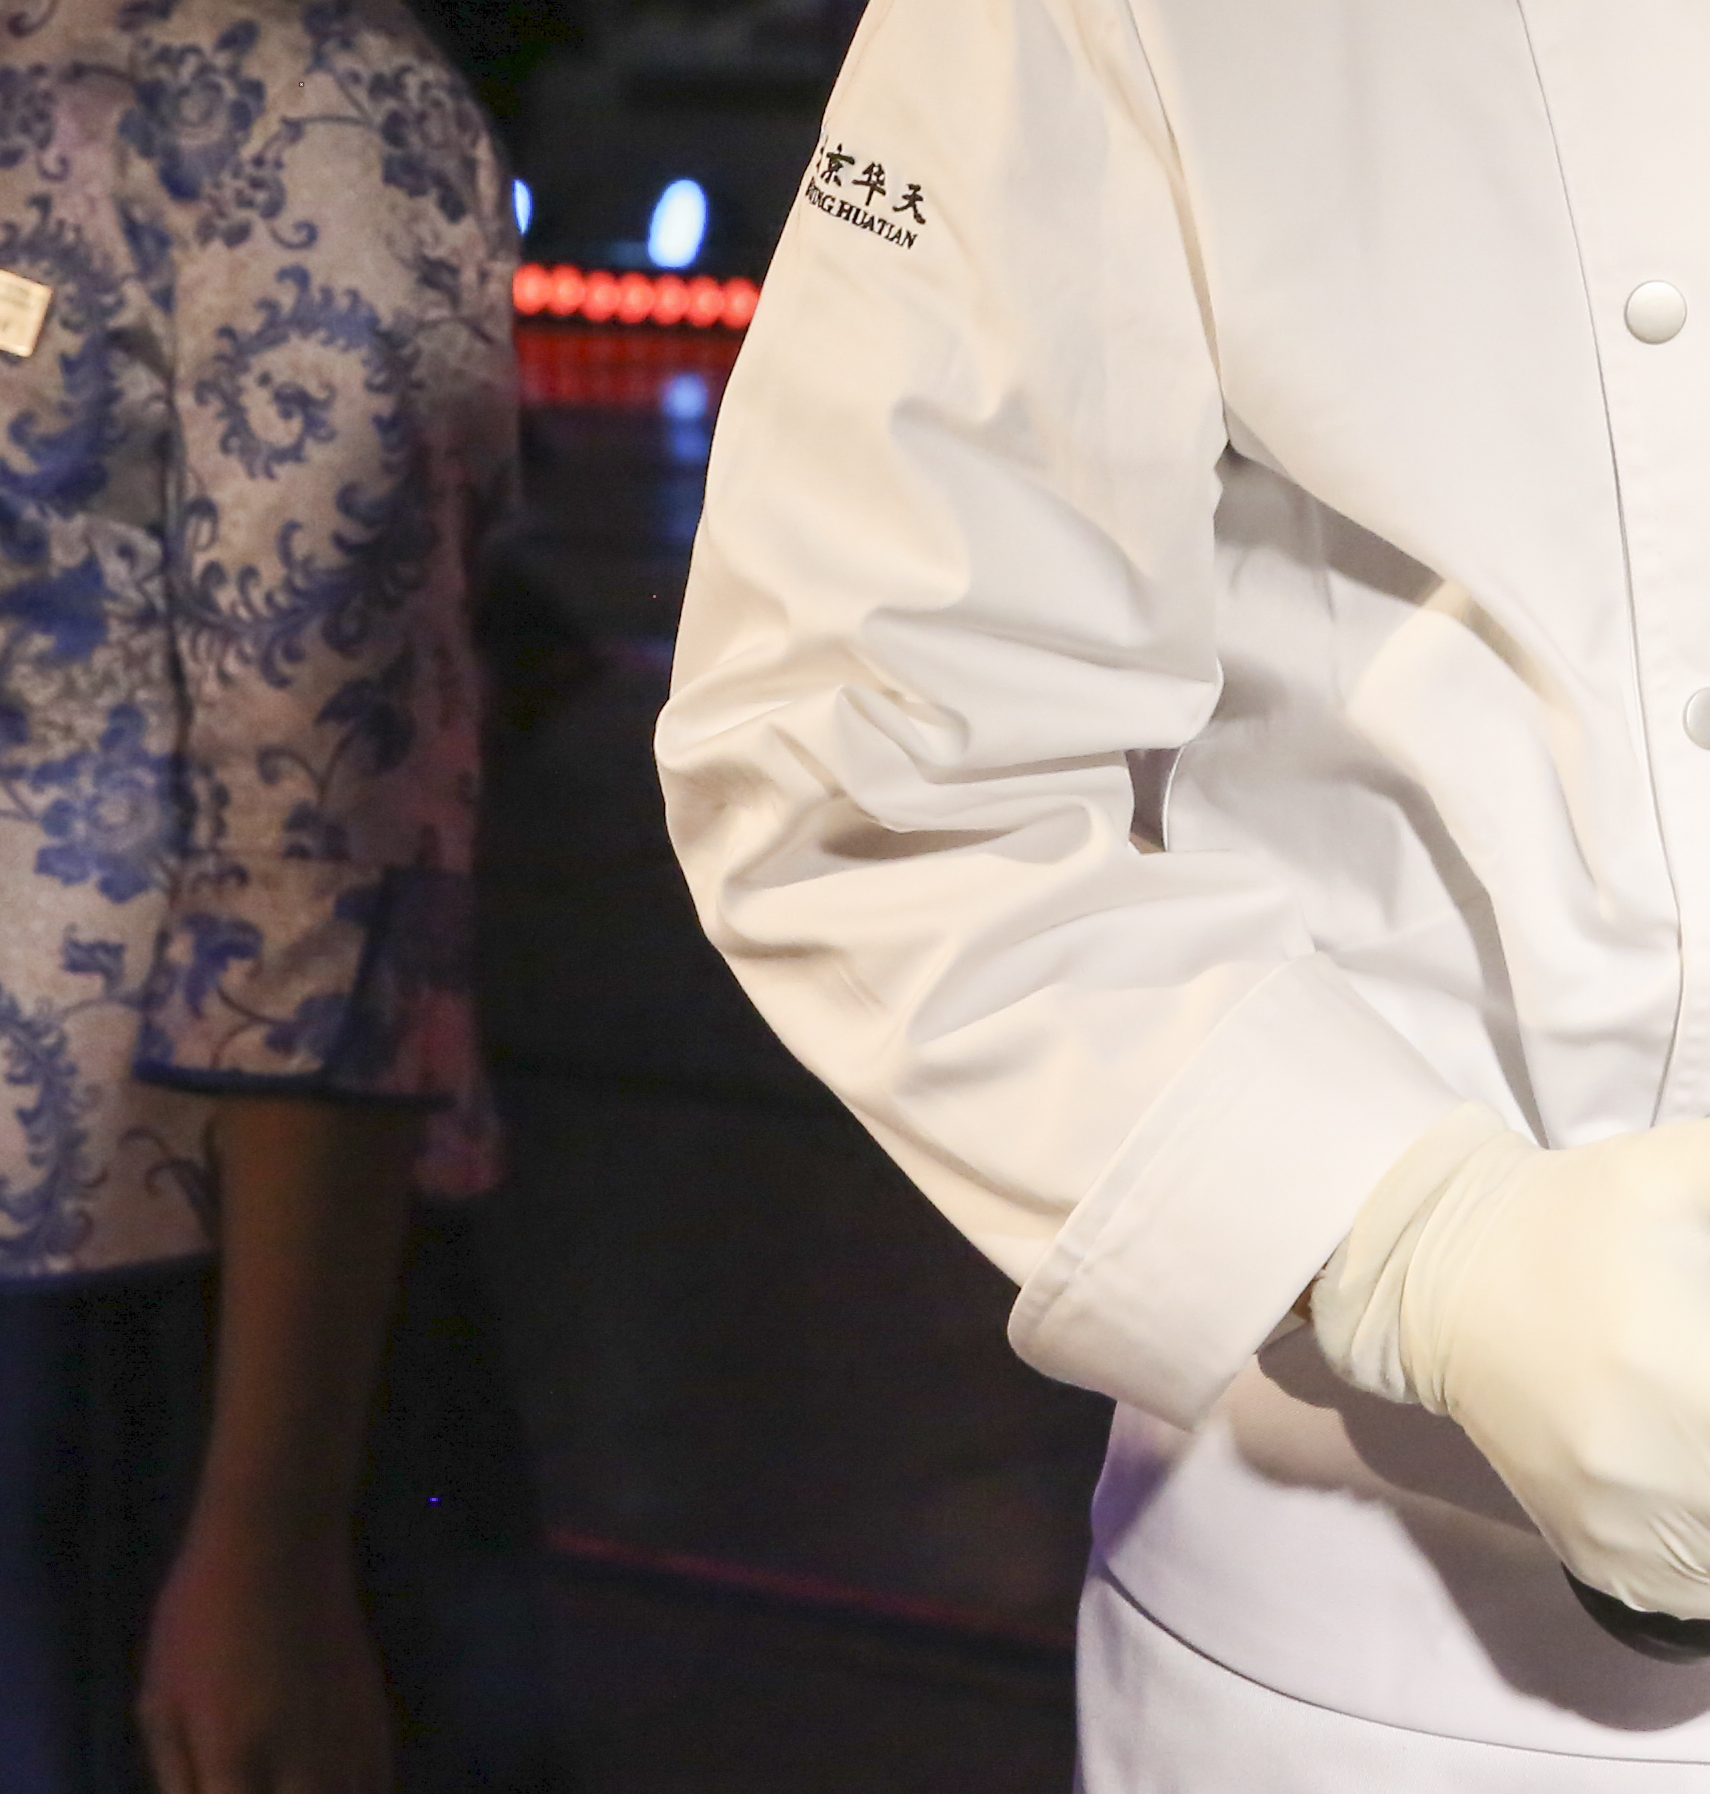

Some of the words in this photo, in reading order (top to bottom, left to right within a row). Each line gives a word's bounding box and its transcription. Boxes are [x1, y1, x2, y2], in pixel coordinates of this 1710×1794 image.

[815, 136, 927, 225] 京华天
[836, 200, 918, 251] HUATIAN
